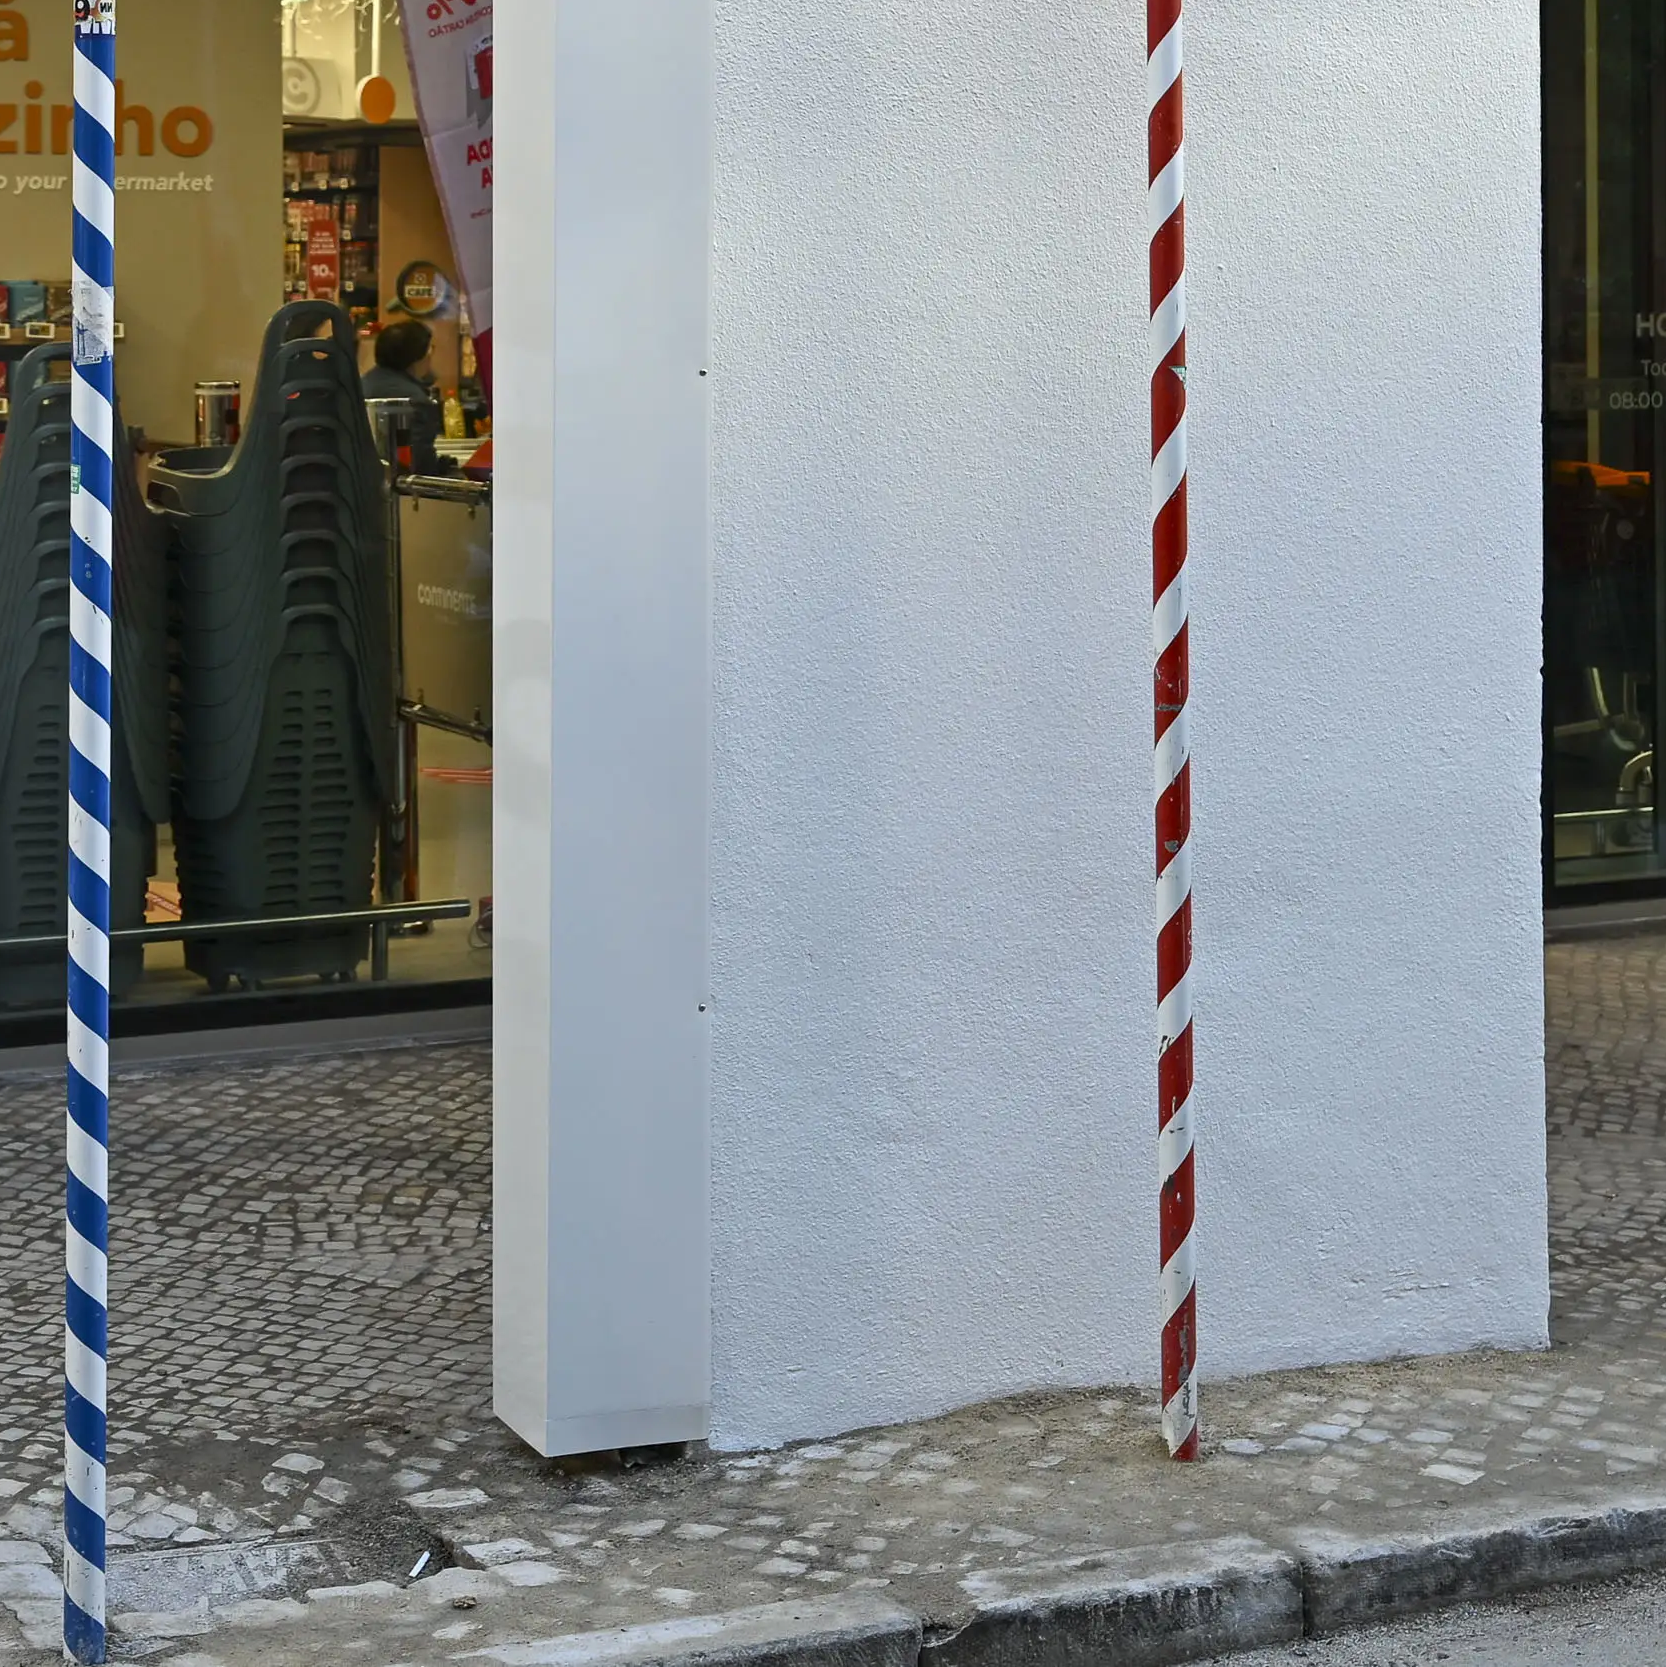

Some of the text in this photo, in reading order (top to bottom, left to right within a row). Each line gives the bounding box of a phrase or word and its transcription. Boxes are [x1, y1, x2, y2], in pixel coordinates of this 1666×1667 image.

[13, 173, 68, 194] your
[114, 172, 214, 192] ermarket
[1609, 392, 1664, 410] 08:00
